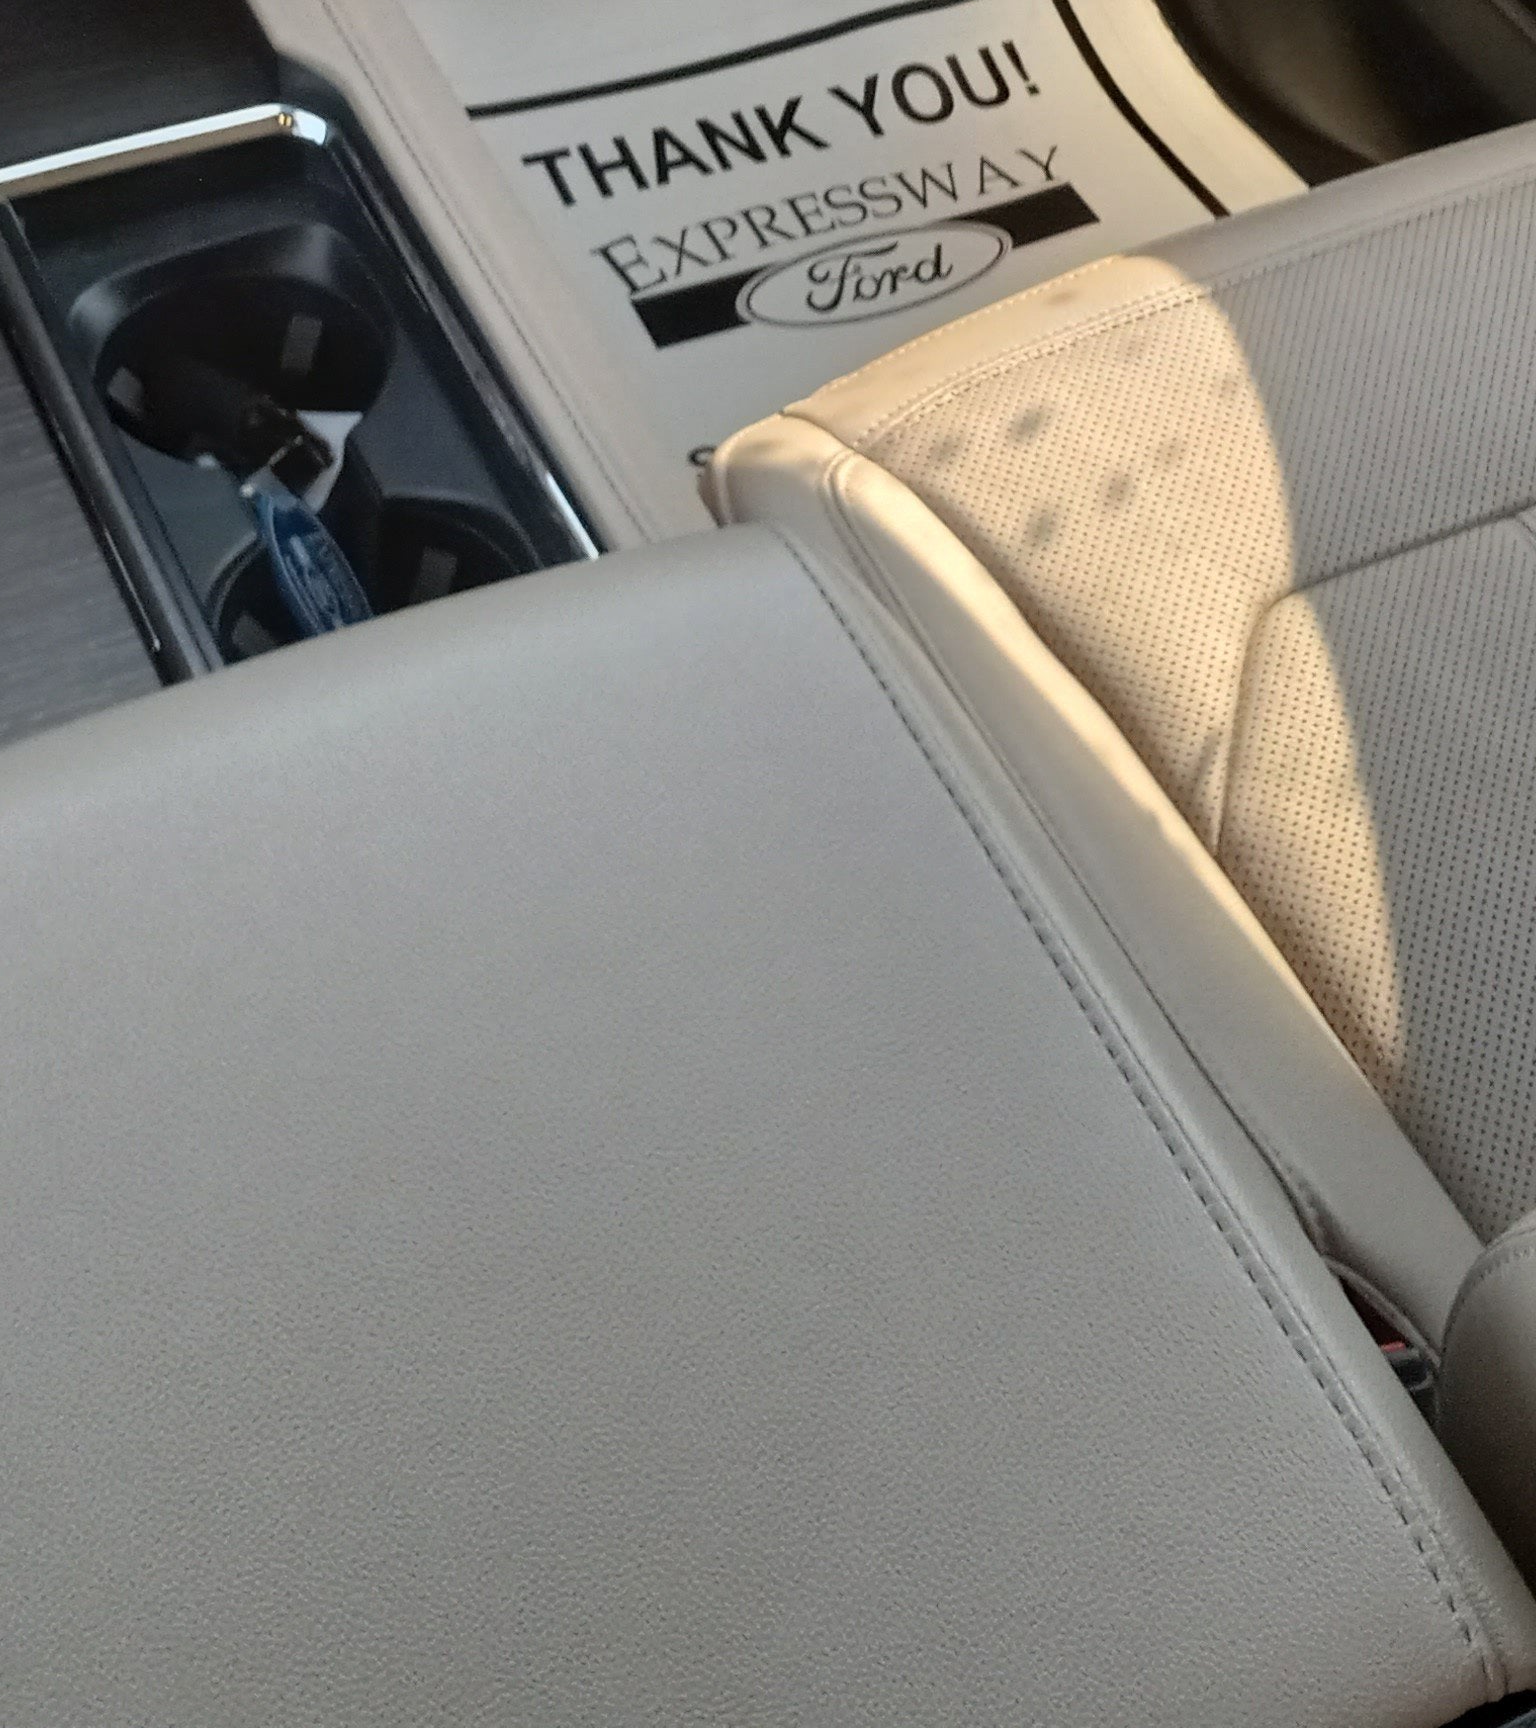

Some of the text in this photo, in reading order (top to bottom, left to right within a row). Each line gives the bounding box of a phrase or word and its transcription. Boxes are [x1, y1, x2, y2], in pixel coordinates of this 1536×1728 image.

[522, 39, 1041, 208] THANK YOU!
[594, 146, 1061, 294] EXPRESSWAY
[804, 241, 955, 314] Ford
